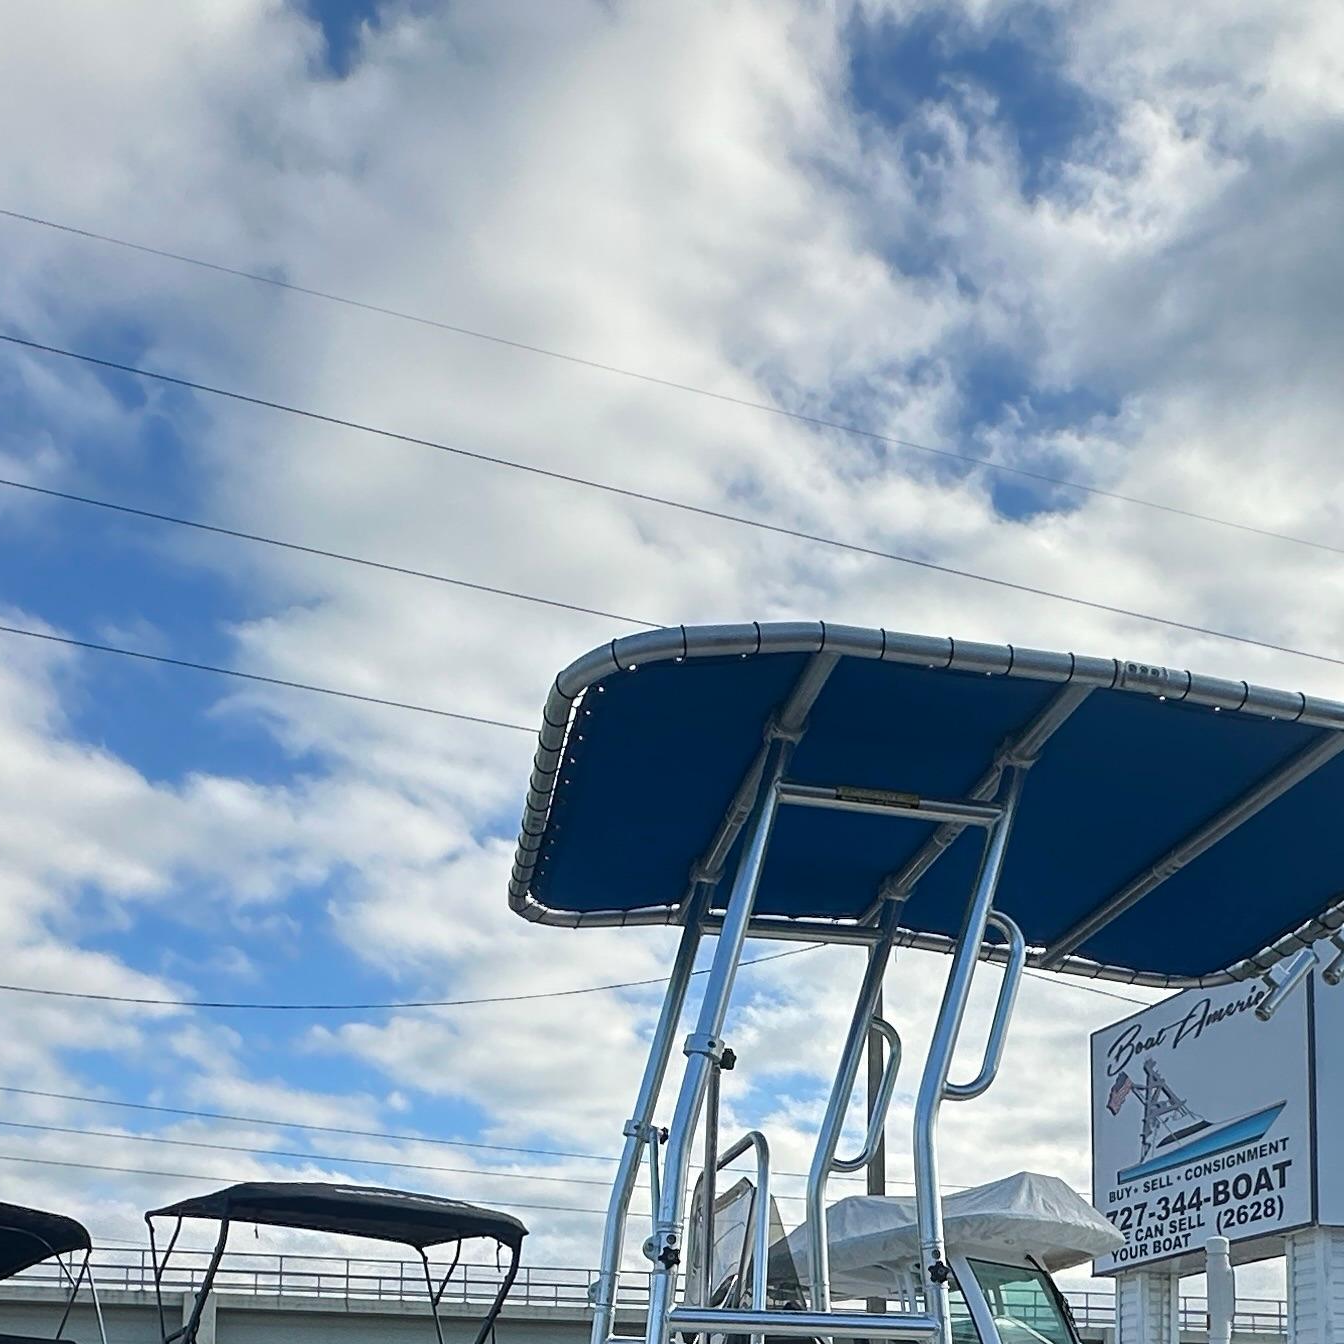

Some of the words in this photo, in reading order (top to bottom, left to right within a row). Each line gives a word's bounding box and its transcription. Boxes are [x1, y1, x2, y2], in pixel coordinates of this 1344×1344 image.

[1107, 1024, 1167, 1077] Boat
[1109, 1186, 1133, 1203] BUY
[1143, 1174, 1174, 1193] SELL
[1184, 1136, 1290, 1181] CONSIGNMENT
[1106, 1159, 1293, 1231] 727-344-BOAT
[1216, 1195, 1285, 1235] (2628)
[1111, 1244, 1149, 1263] YOUR
[1152, 1233, 1192, 1254] BOAT
[1135, 1223, 1164, 1242] CAN
[1169, 1214, 1206, 1234] SELL
